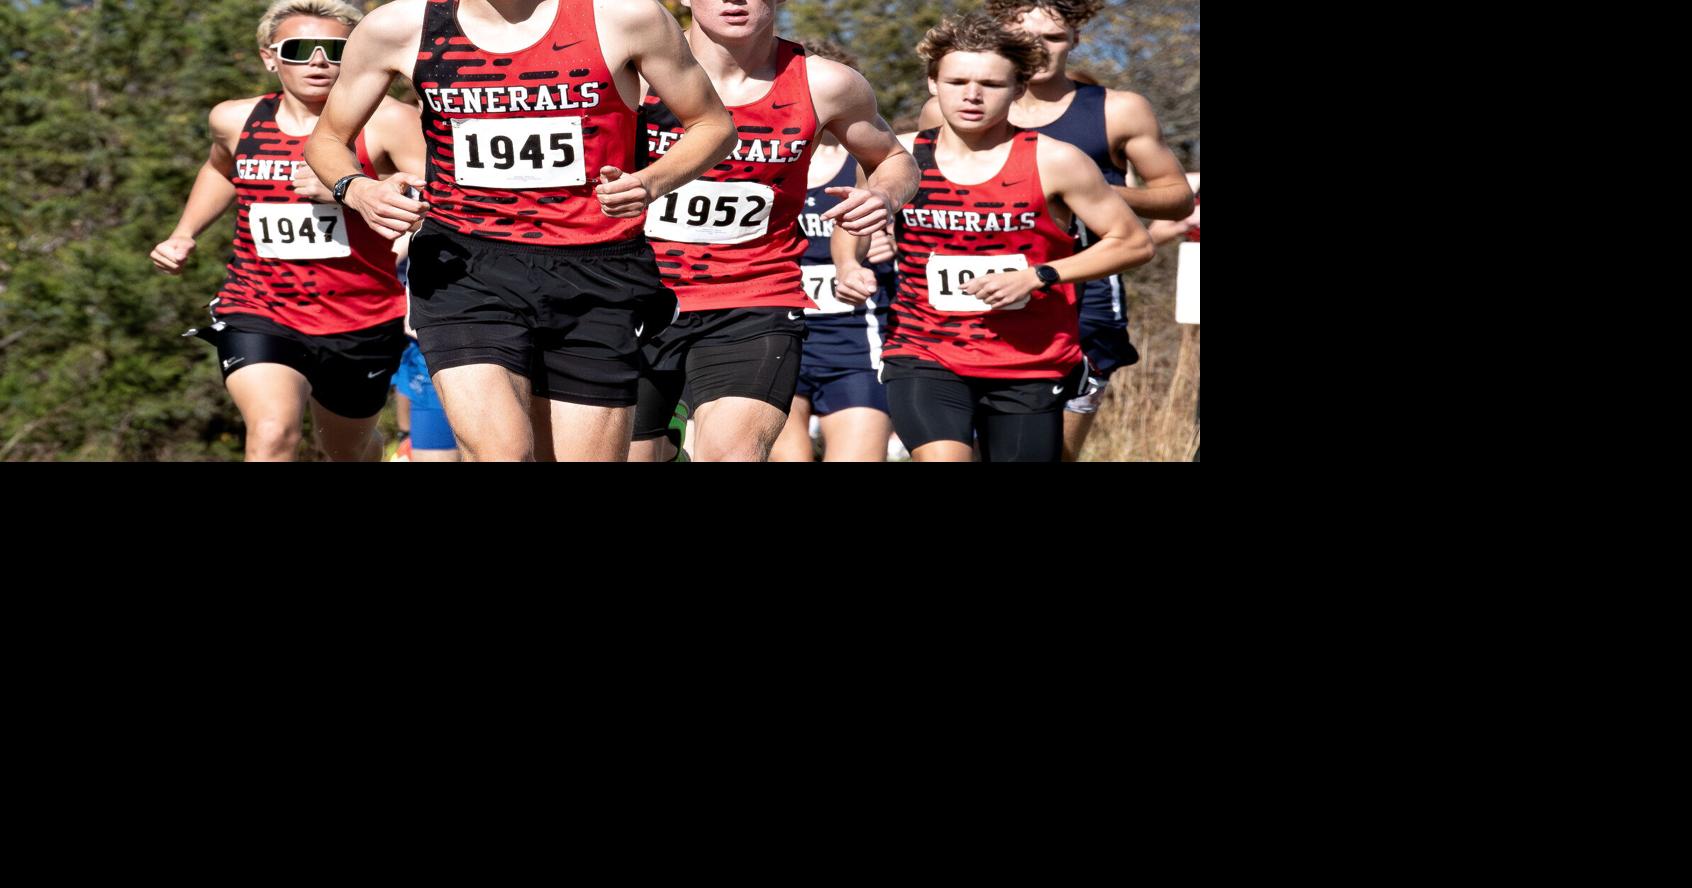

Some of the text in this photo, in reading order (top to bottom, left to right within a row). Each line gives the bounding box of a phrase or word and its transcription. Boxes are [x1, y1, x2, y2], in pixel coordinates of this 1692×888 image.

[424, 81, 600, 113] GENERALS
[465, 132, 575, 169] 1945
[659, 192, 767, 227] 1952
[902, 208, 1036, 232] GENERALS
[259, 215, 338, 244] 1947
[938, 267, 1019, 295] 19
